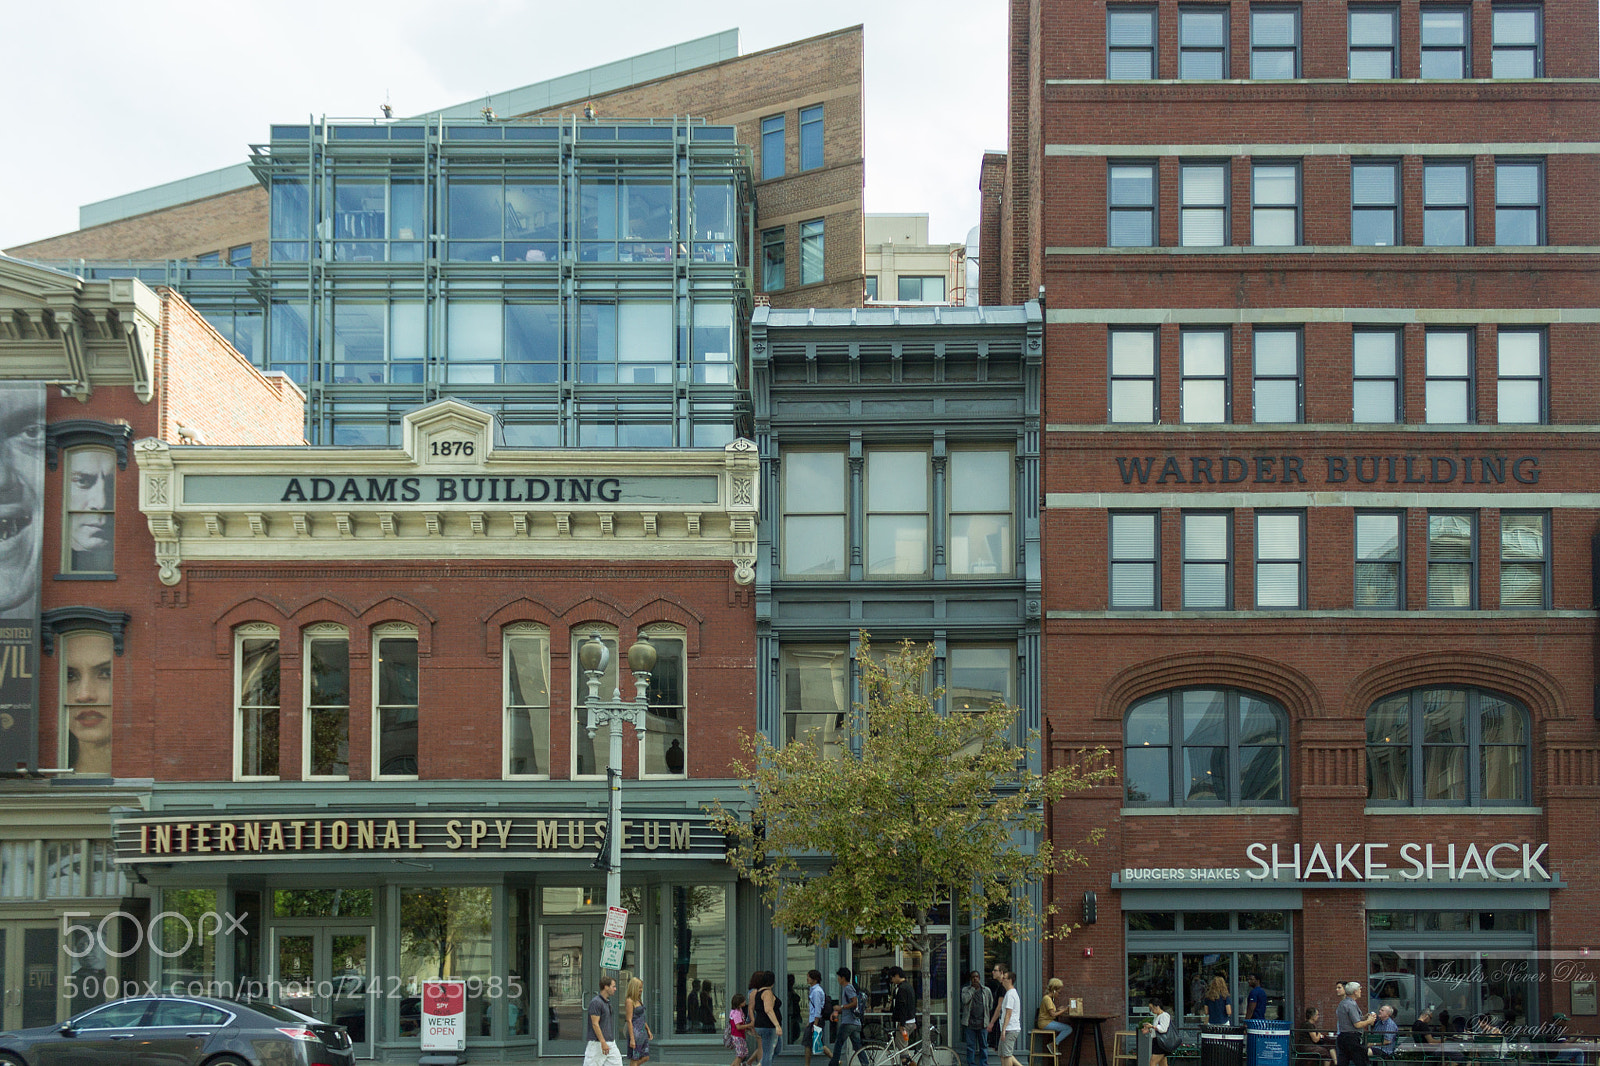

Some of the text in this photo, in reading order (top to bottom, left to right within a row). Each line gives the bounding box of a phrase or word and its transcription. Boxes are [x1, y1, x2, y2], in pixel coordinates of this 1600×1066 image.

[431, 440, 475, 457] 1876
[1116, 455, 1542, 485] WARDER BUILDING
[281, 477, 623, 503] ADAMS BUILDING
[140, 819, 692, 854] INTERNATIONAL SPY MUSEUM
[1245, 842, 1551, 881] SHAKE SHACK
[1125, 868, 1241, 880] BURGERS SHAKES
[428, 1018, 457, 1026] WE'RE
[429, 1027, 455, 1036] OPEN
